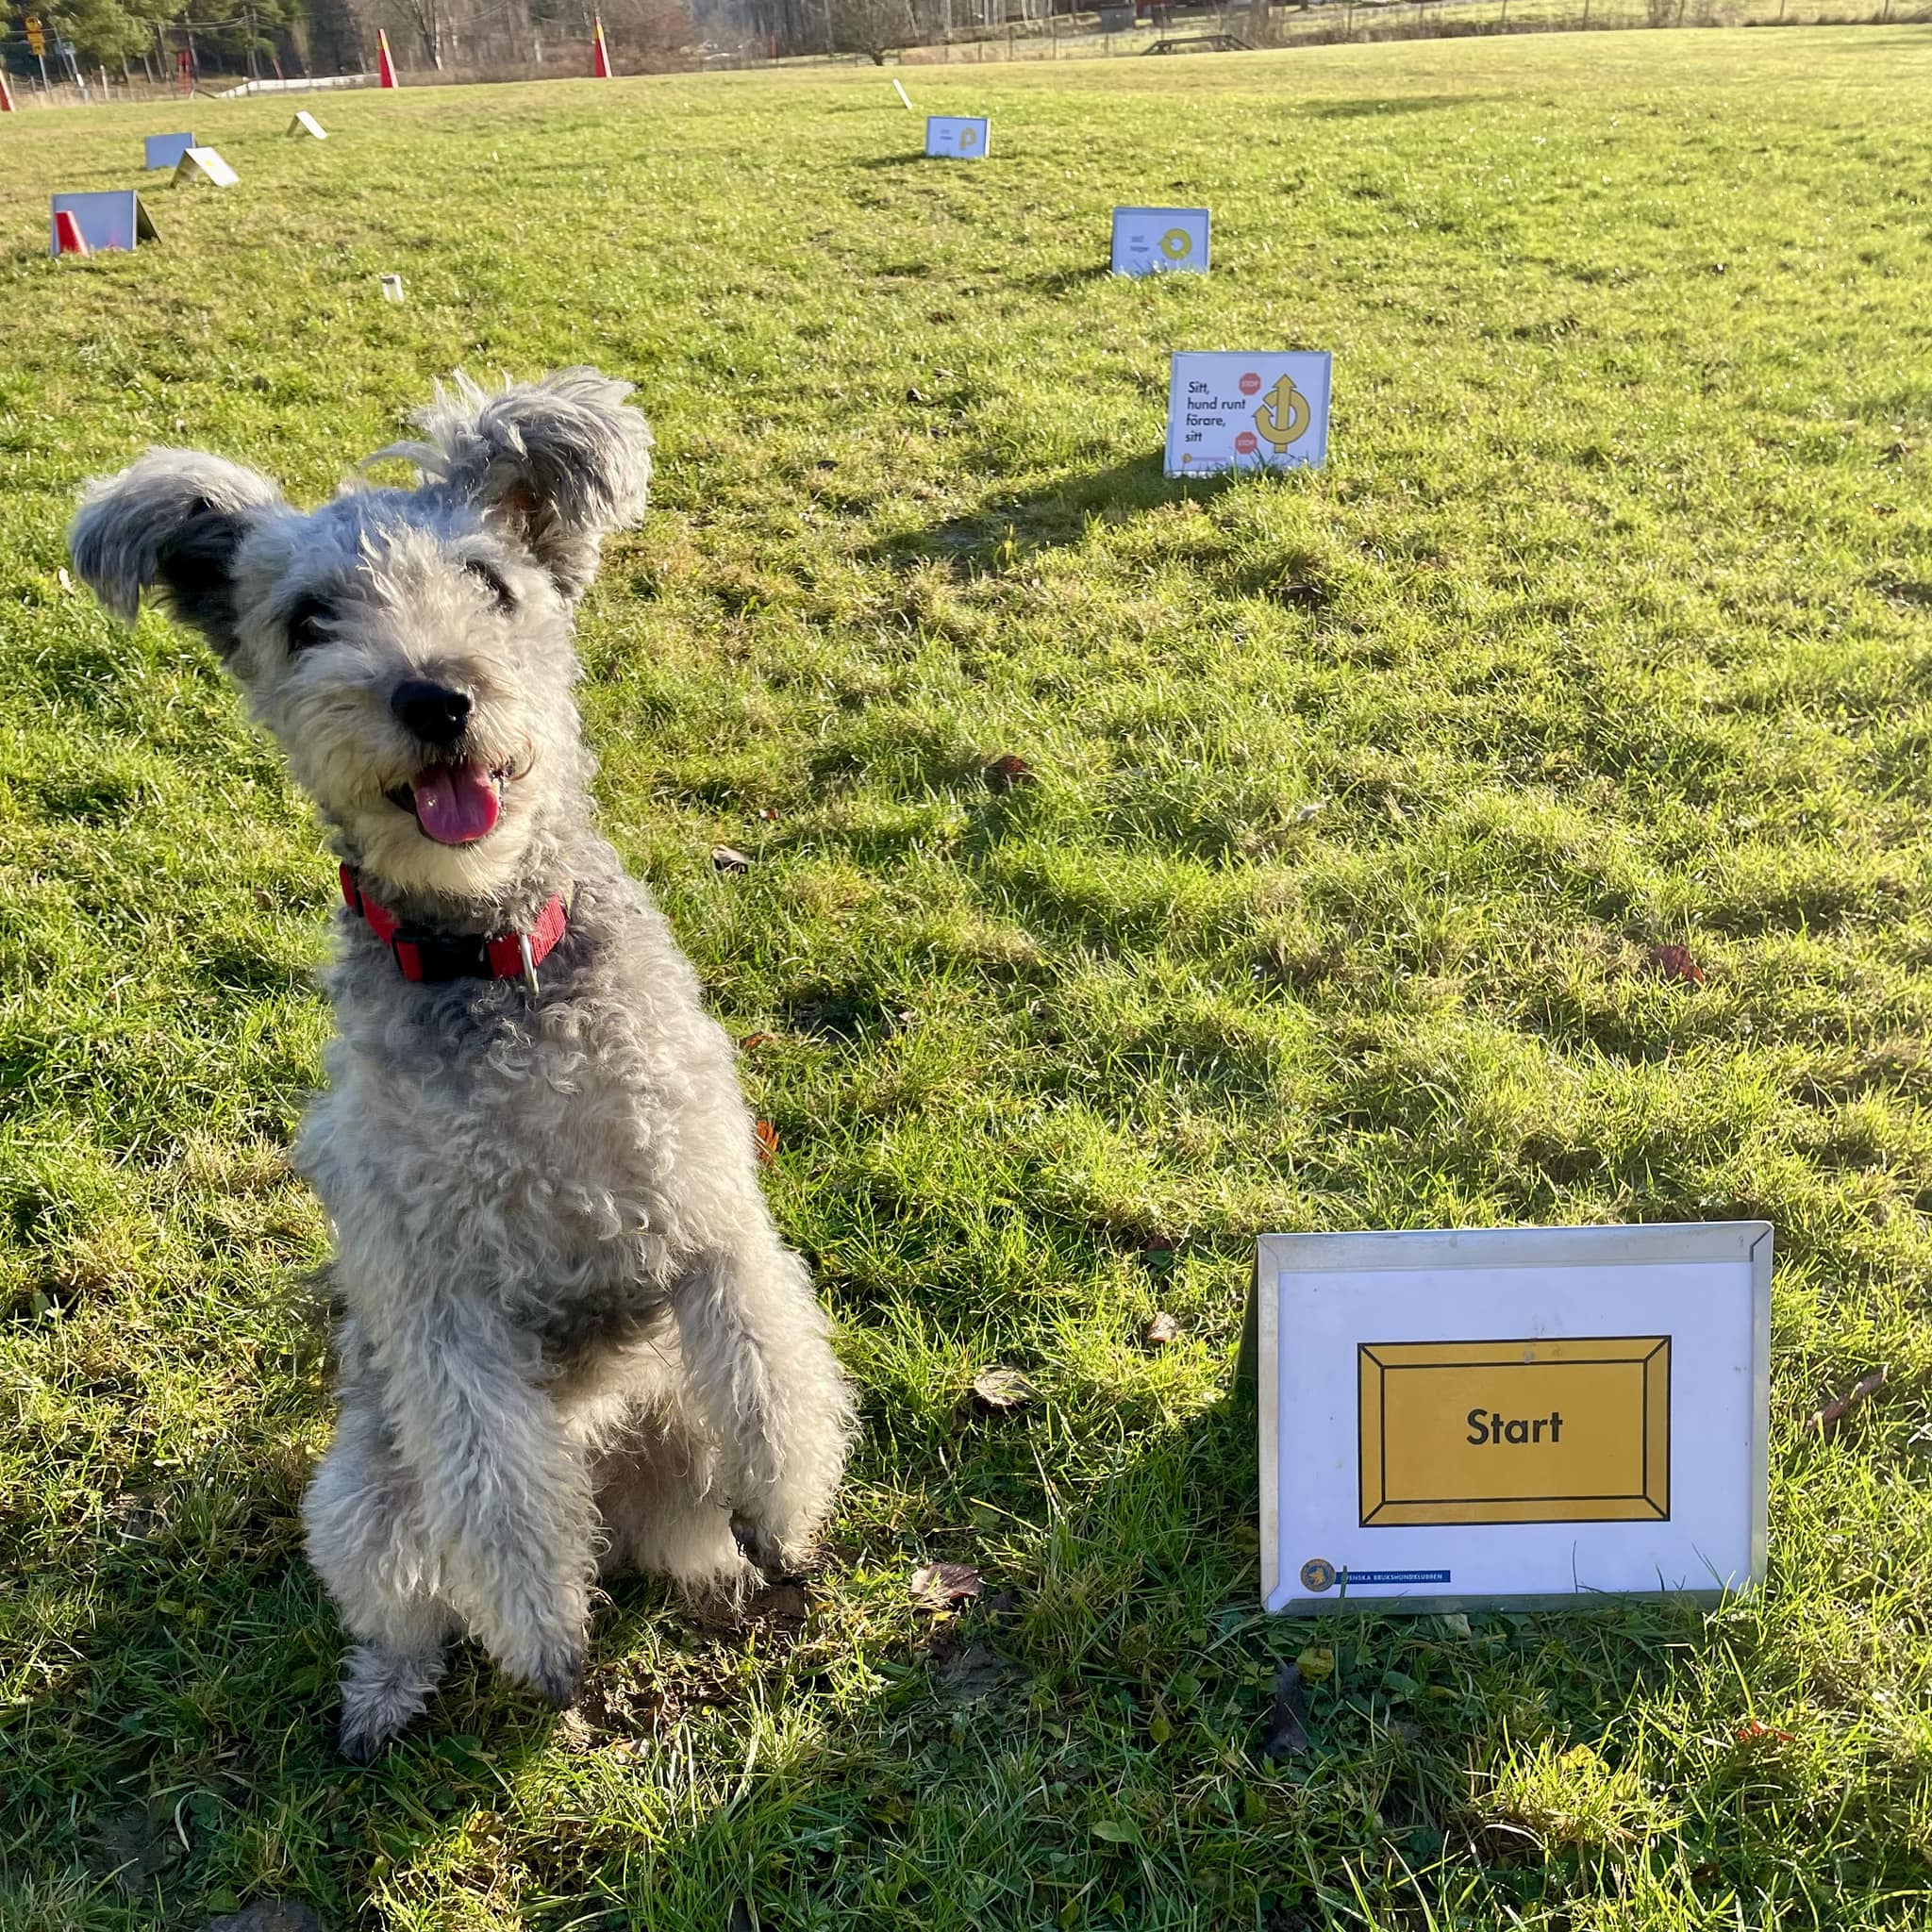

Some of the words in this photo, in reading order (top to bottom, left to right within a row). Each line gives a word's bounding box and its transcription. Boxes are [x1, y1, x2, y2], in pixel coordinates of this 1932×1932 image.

[1188, 380, 1209, 395] Sitt,
[1187, 396, 1218, 409] hund
[1221, 399, 1246, 409] runt
[1186, 413, 1226, 427] förare,
[1185, 430, 1203, 442] sitt
[1466, 1408, 1563, 1445] Start
